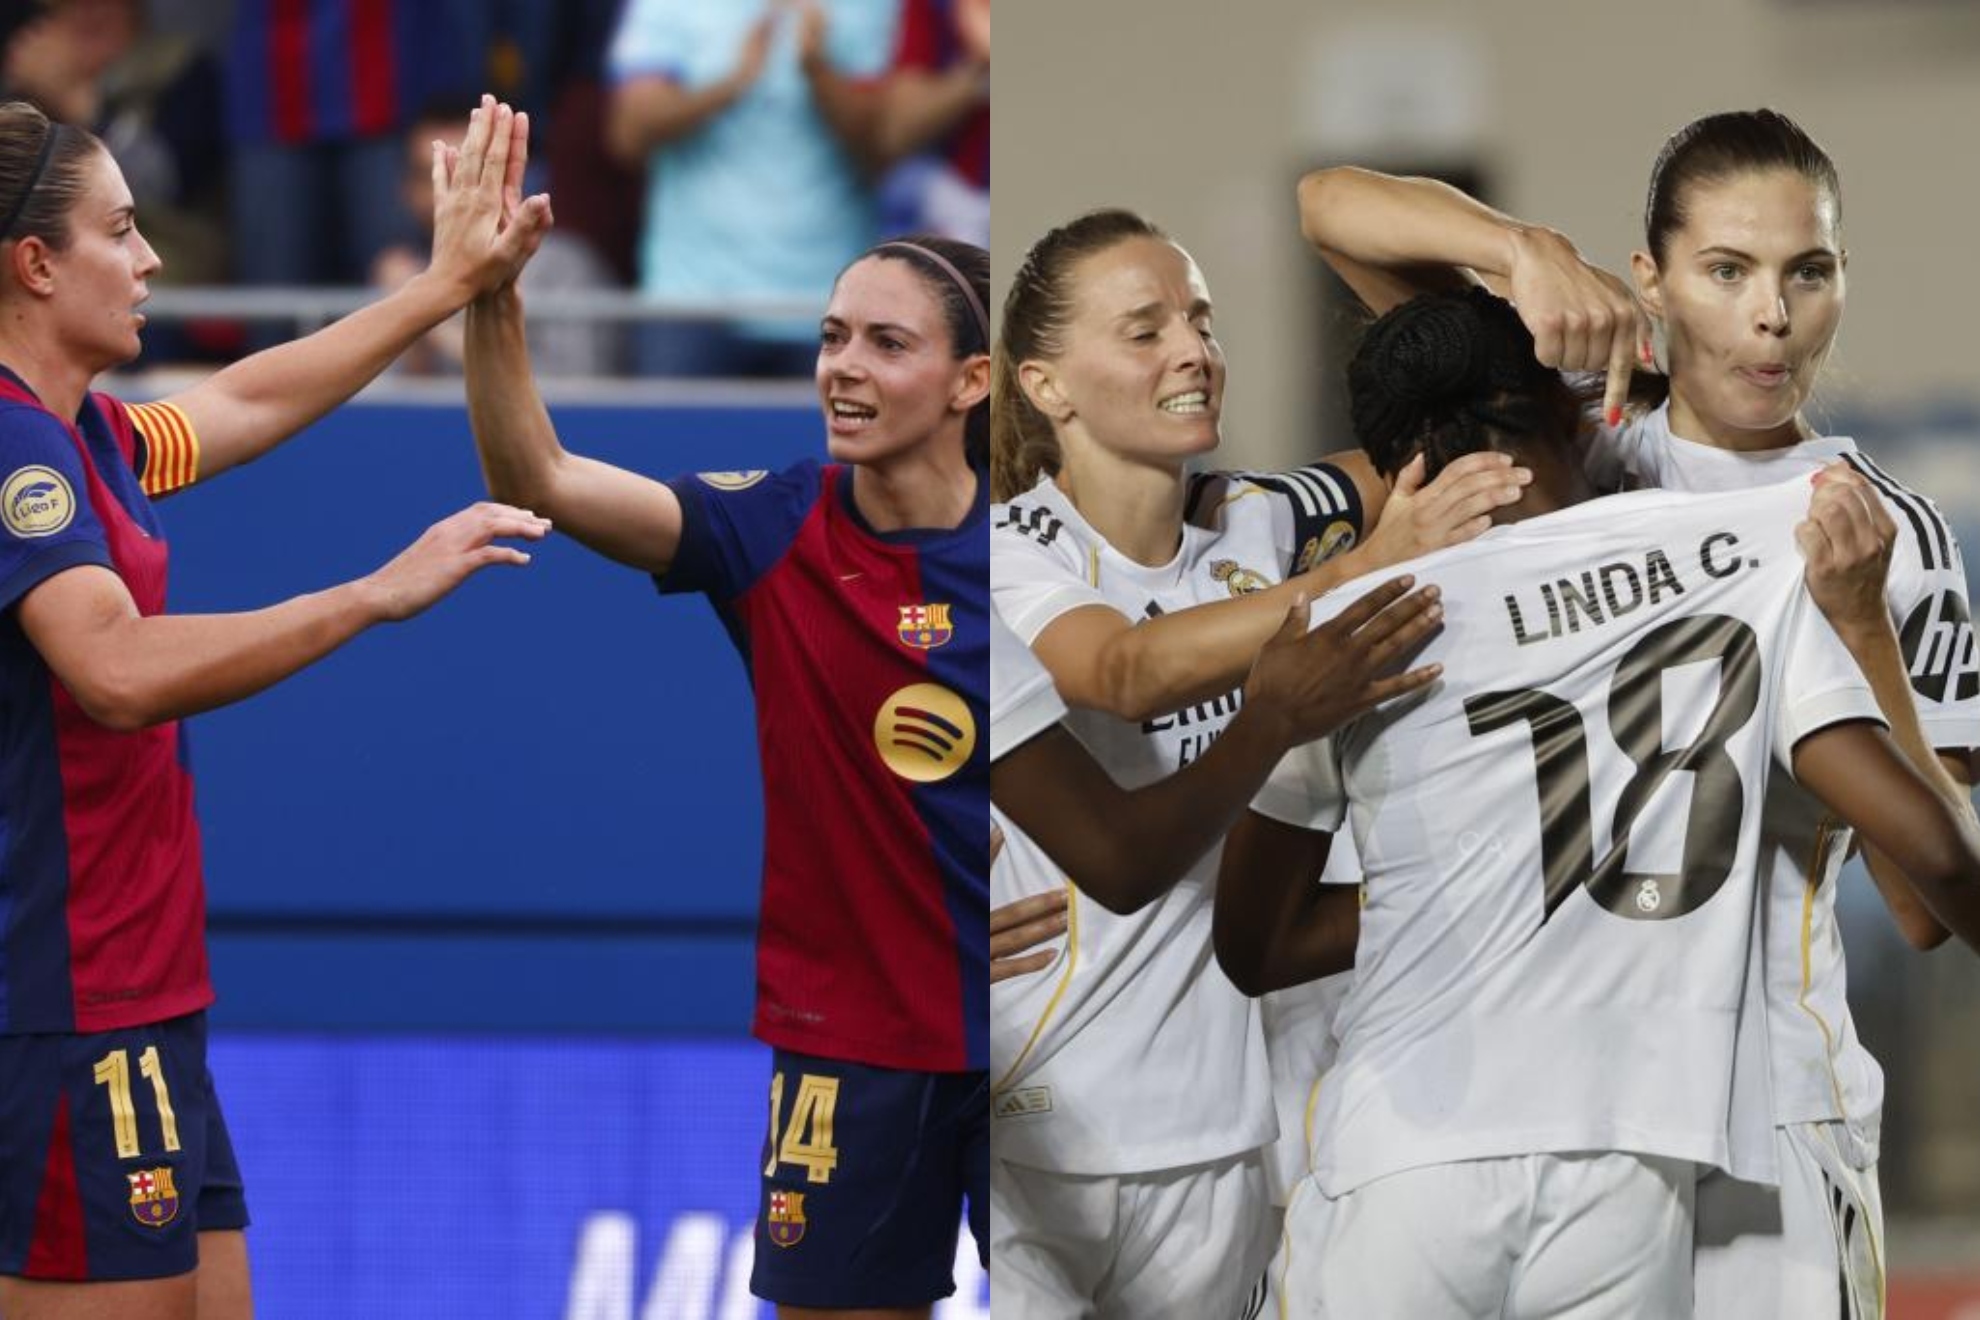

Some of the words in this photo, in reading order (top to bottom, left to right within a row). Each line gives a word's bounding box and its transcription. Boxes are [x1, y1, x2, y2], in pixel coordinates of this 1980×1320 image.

[1504, 549, 1685, 646] LINDA
[1699, 532, 1760, 579] C.
[1909, 588, 1980, 702] hp
[1463, 613, 1761, 926] 18
[93, 1046, 181, 1158] 11
[764, 1071, 840, 1184] 14
